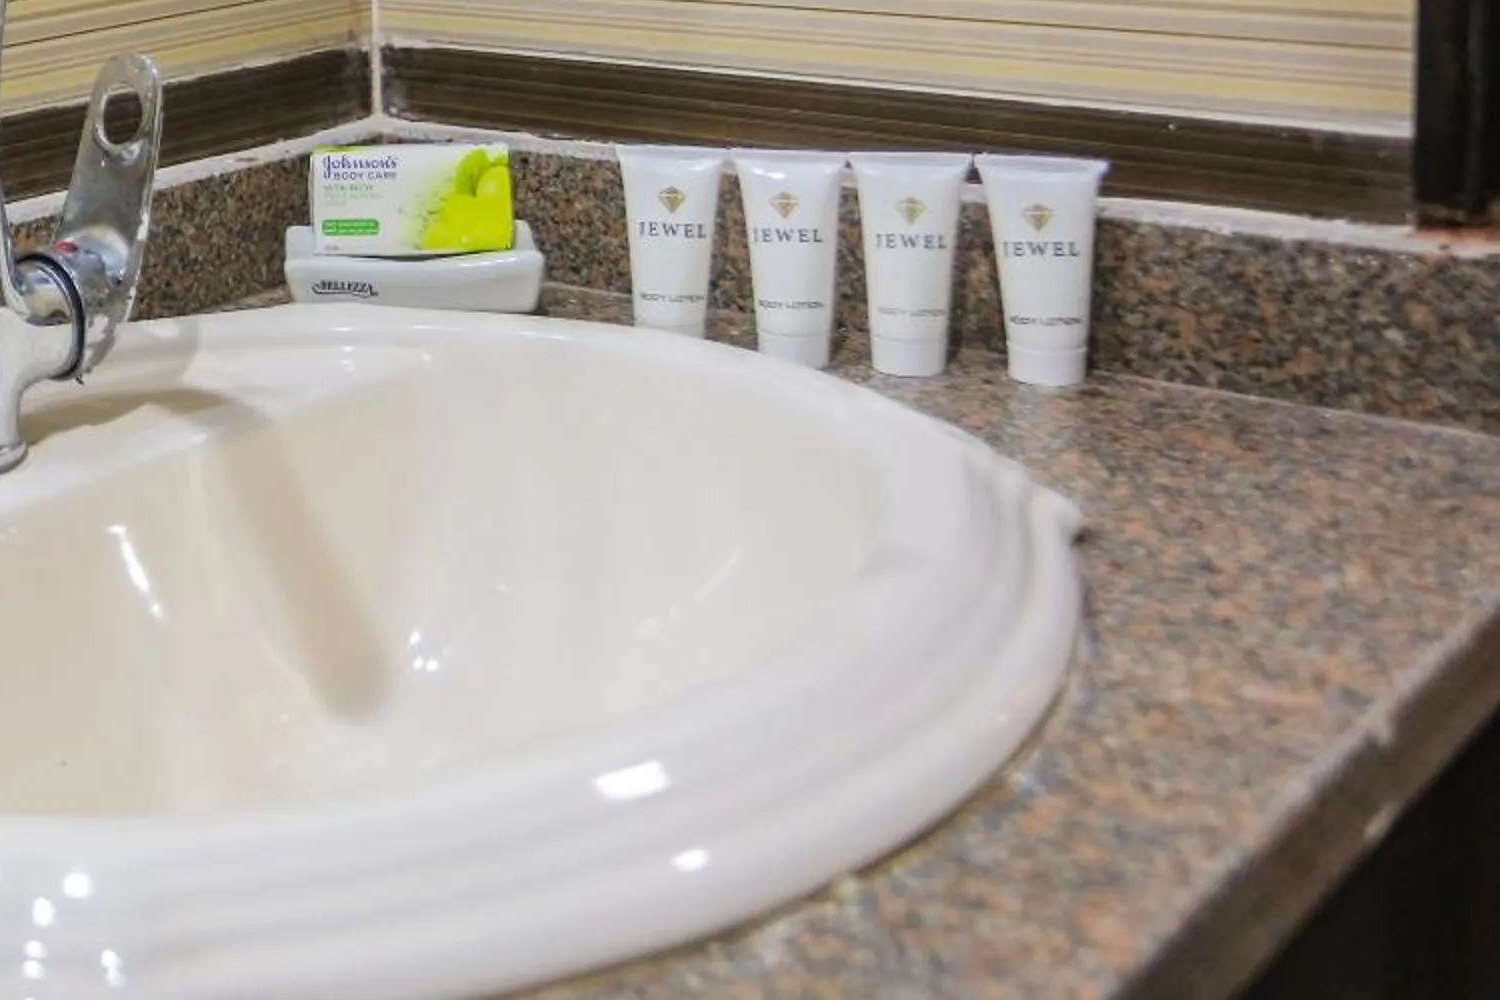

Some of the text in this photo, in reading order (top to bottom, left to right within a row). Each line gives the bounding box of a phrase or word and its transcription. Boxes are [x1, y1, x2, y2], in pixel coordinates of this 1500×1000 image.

[639, 221, 707, 239] JEWEL
[753, 227, 824, 243] JEWEL
[876, 233, 948, 249] JEWEL
[1003, 241, 1081, 257] JEWEL
